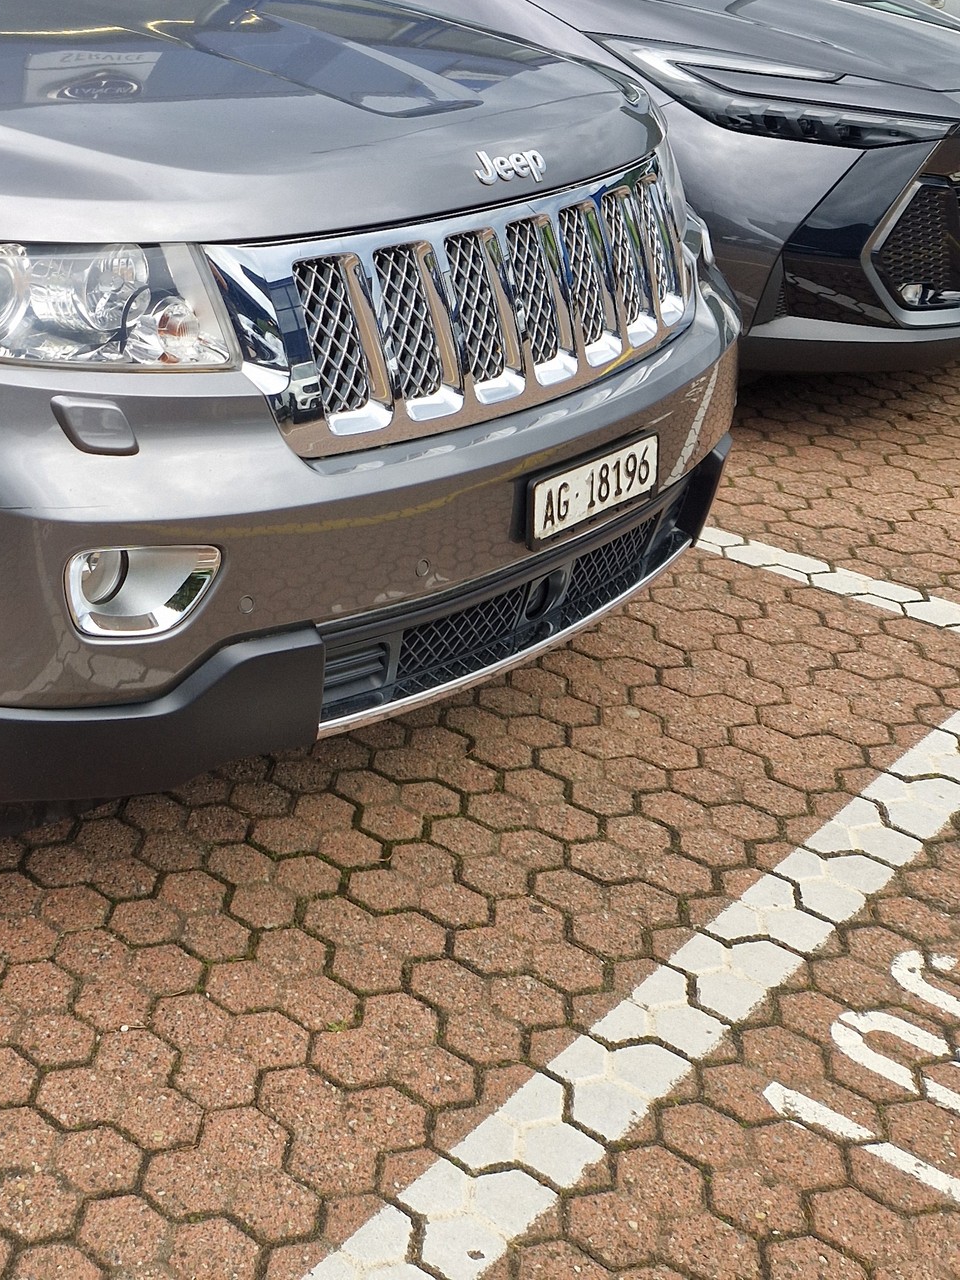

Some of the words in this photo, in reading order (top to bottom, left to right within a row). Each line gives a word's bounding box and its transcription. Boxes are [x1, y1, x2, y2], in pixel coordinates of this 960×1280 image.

[475, 149, 547, 186] Jeep
[543, 481, 570, 530] AG
[587, 445, 650, 509] 18196
